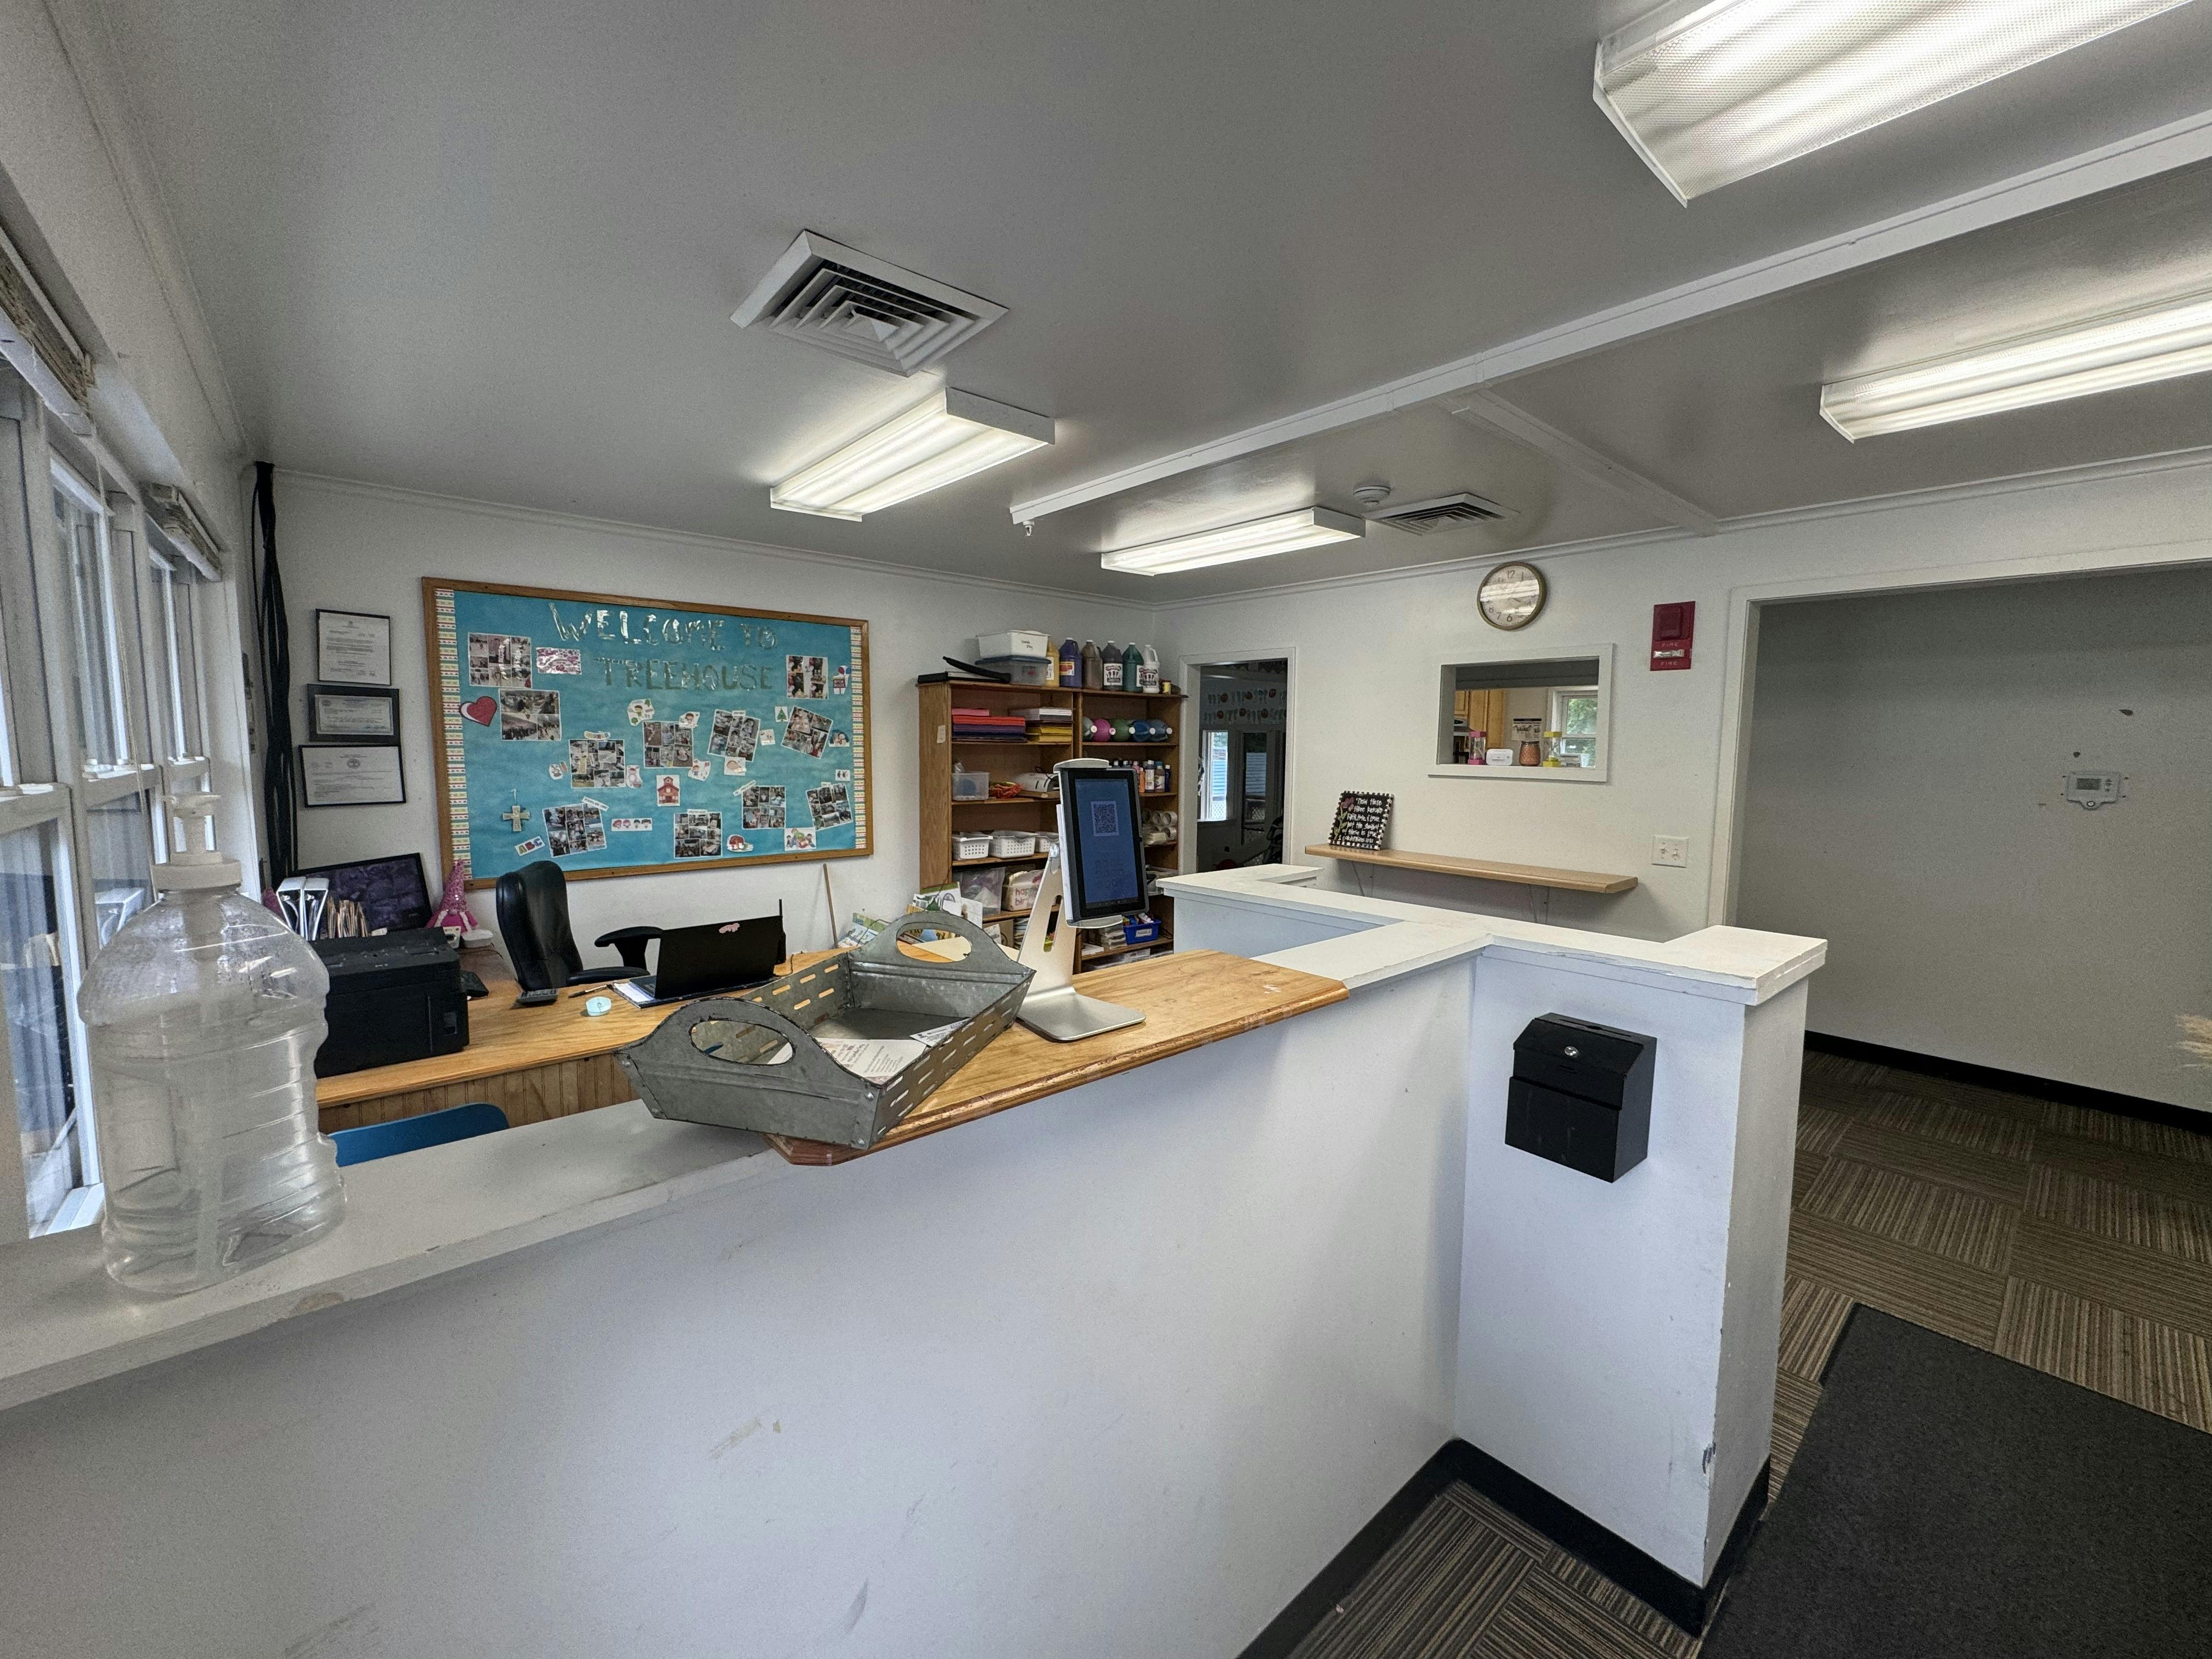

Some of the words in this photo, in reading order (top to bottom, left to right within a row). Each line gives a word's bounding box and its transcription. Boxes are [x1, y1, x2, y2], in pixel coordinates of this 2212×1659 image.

[1507, 570, 1515, 579] 12
[1506, 613, 1513, 622] 6
[549, 602, 726, 651] WELCOME
[739, 623, 777, 651] TO
[592, 658, 774, 691] TREEHOUSE
[519, 838, 543, 854] ABC
